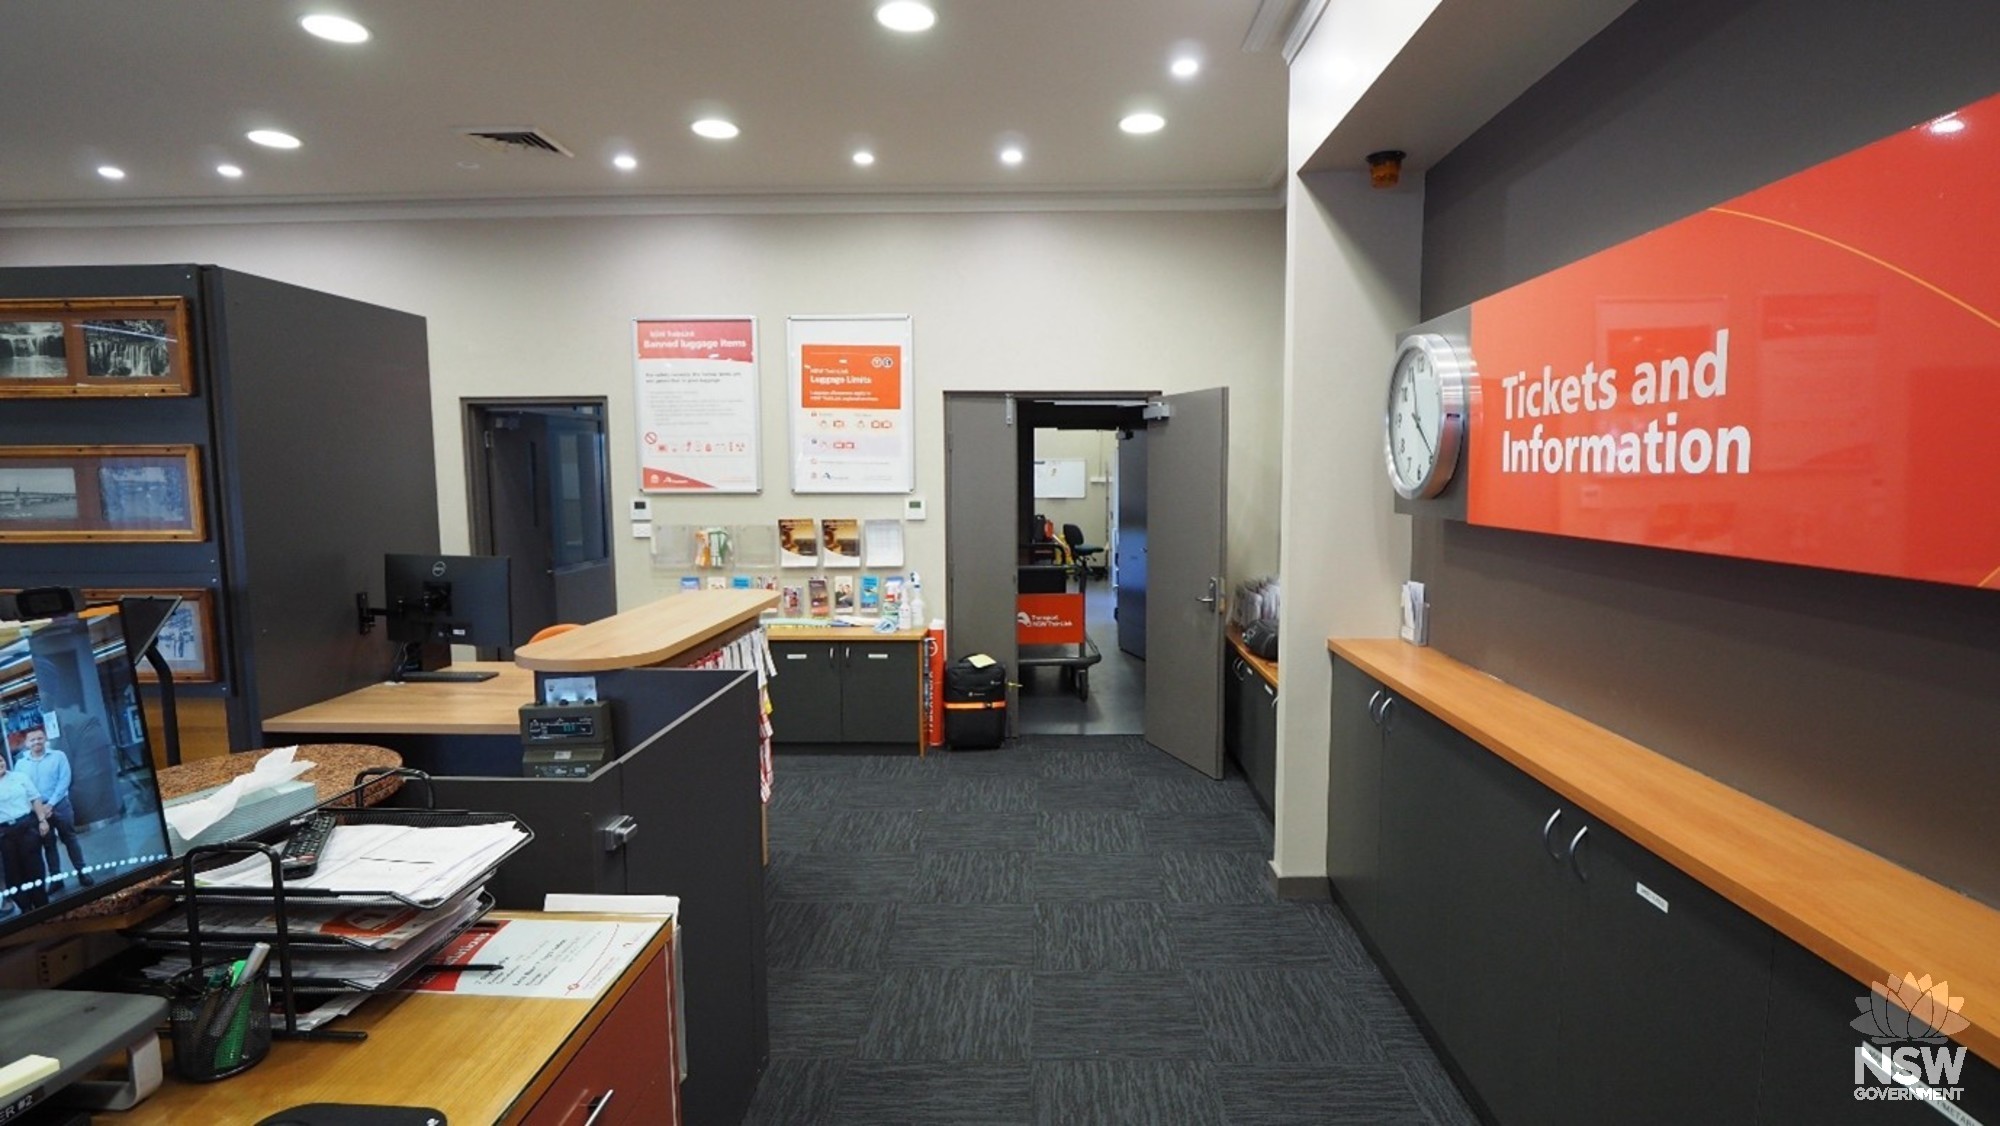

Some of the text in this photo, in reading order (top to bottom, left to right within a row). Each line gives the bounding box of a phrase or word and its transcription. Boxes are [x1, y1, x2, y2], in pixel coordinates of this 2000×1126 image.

[643, 338, 747, 350] Banned luggage items
[810, 375, 872, 385] Luggage Limits
[1502, 328, 1729, 420] Tickets and
[1502, 411, 1751, 474] Information
